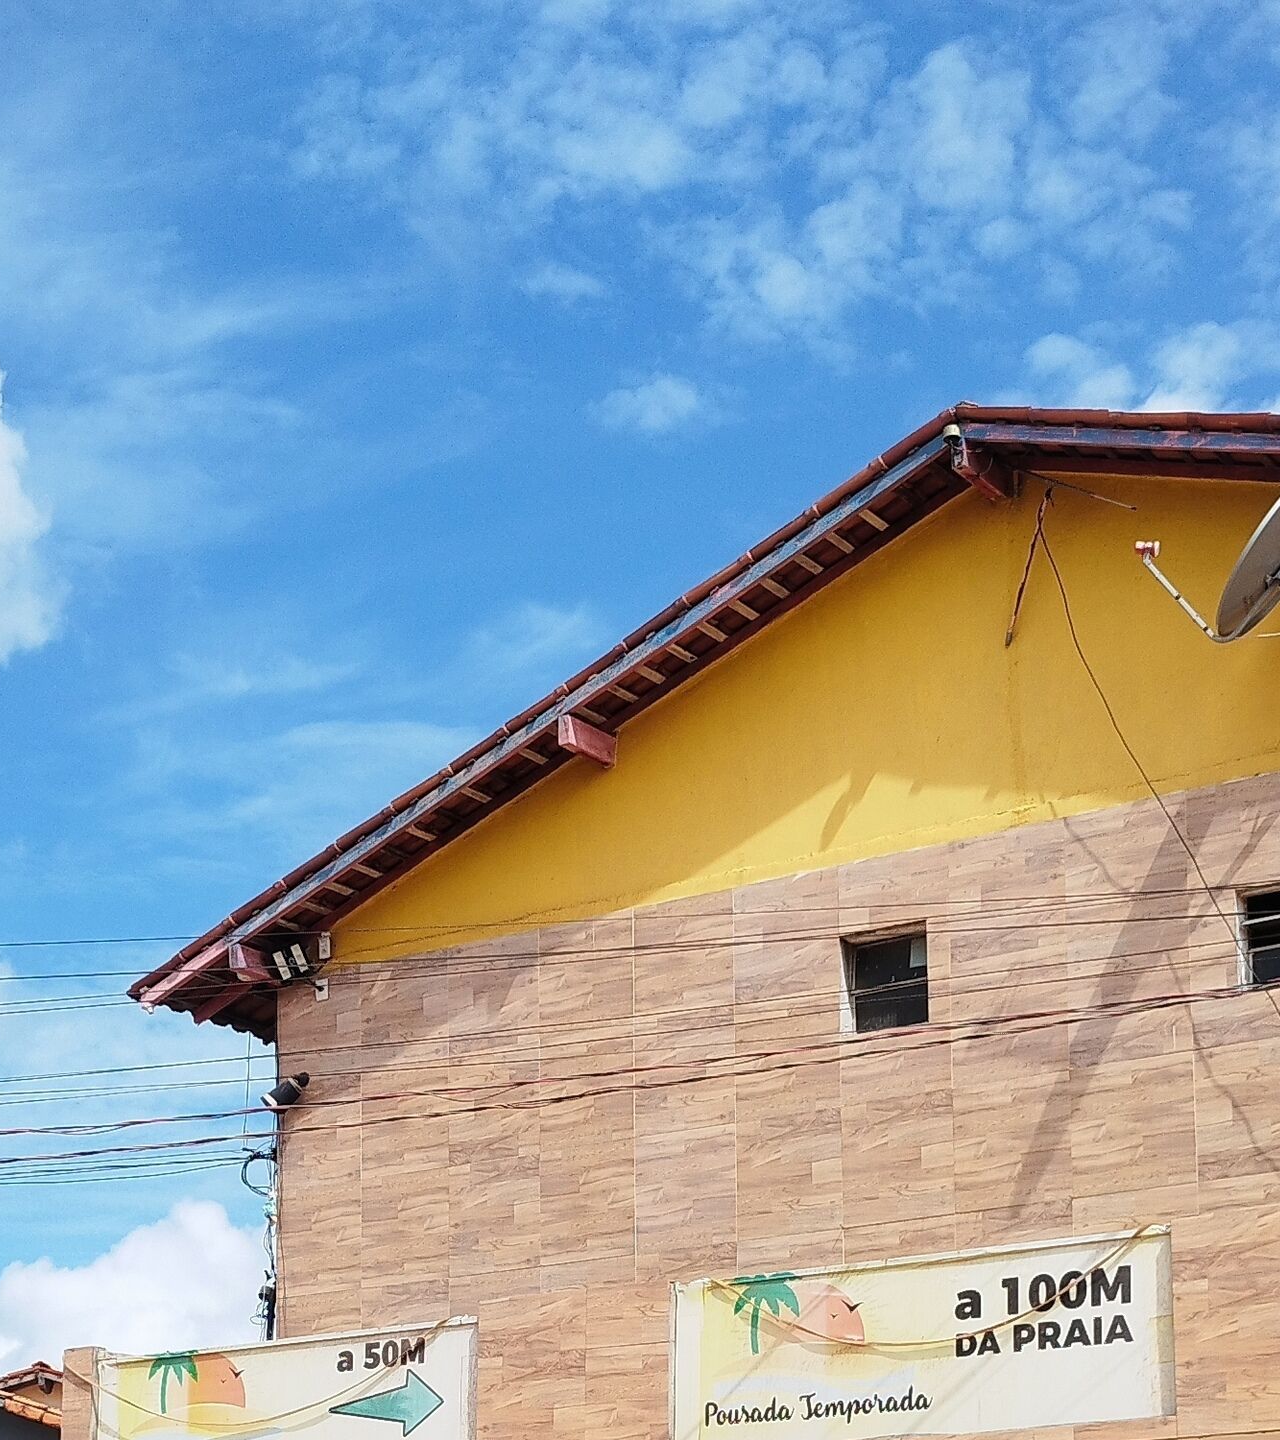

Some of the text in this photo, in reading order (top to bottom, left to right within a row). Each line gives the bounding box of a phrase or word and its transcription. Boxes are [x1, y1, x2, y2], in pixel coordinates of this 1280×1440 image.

[954, 1265, 1132, 1320] a 100M
[336, 1336, 426, 1373] a 50M
[955, 1314, 1134, 1358] DA PRAIA
[704, 1384, 934, 1427] Pousada Temporada
